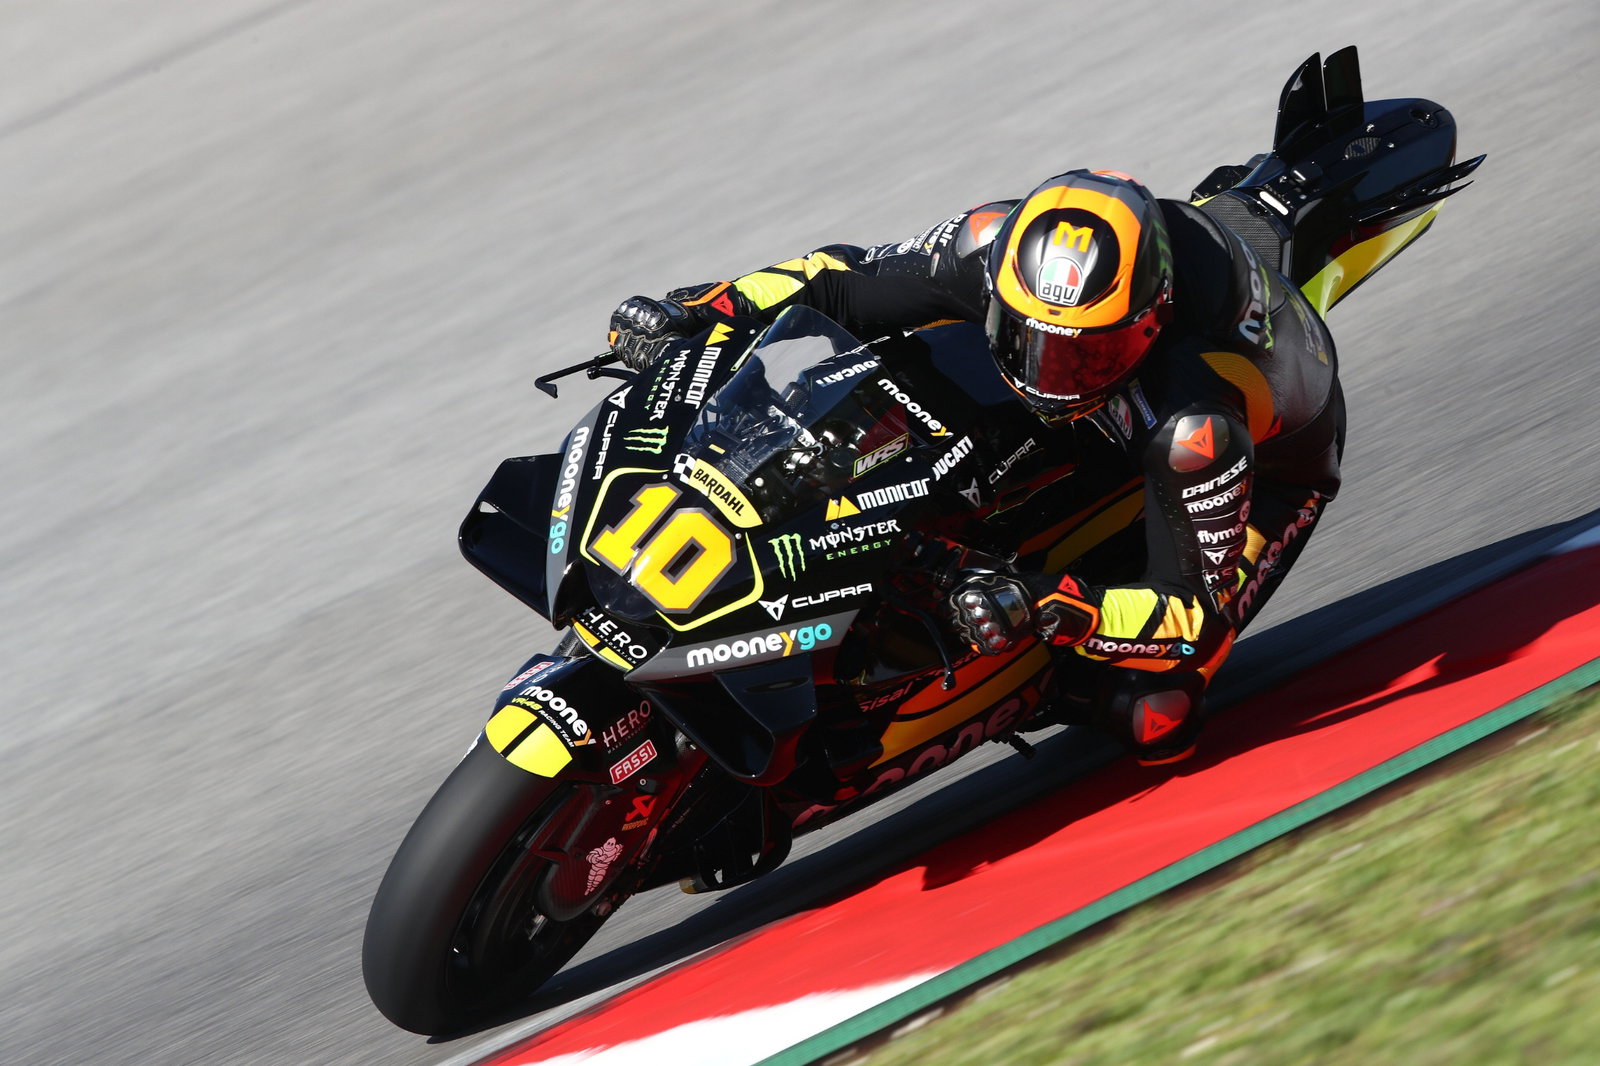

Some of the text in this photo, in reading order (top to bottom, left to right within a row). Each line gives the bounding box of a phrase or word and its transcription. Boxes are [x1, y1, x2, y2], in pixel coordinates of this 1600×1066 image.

[1052, 221, 1095, 253] M
[1042, 282, 1075, 302] agv
[1026, 317, 1083, 338] mooney
[644, 359, 671, 411] ENERGY
[649, 349, 691, 421] MONSTER
[877, 378, 954, 437] mooney
[1025, 386, 1081, 400] CUPRA
[592, 410, 618, 480] CUPRA
[855, 437, 908, 475] WRS
[988, 437, 1036, 485] CUPRA
[549, 426, 589, 555] mooneygo
[693, 468, 745, 517] BARDAHL
[1182, 456, 1248, 499] DAINESE
[587, 482, 737, 614] 10
[808, 519, 901, 551] MONSTER
[826, 539, 892, 561] ENERGY
[791, 583, 873, 609] CUPRA
[583, 606, 648, 659] HERO
[686, 622, 833, 668] mooneygo
[519, 685, 597, 747] mooney
[538, 710, 562, 730] RACING
[560, 730, 575, 748] TEAM
[602, 700, 651, 748] HERO
[614, 745, 653, 780] FASSI
